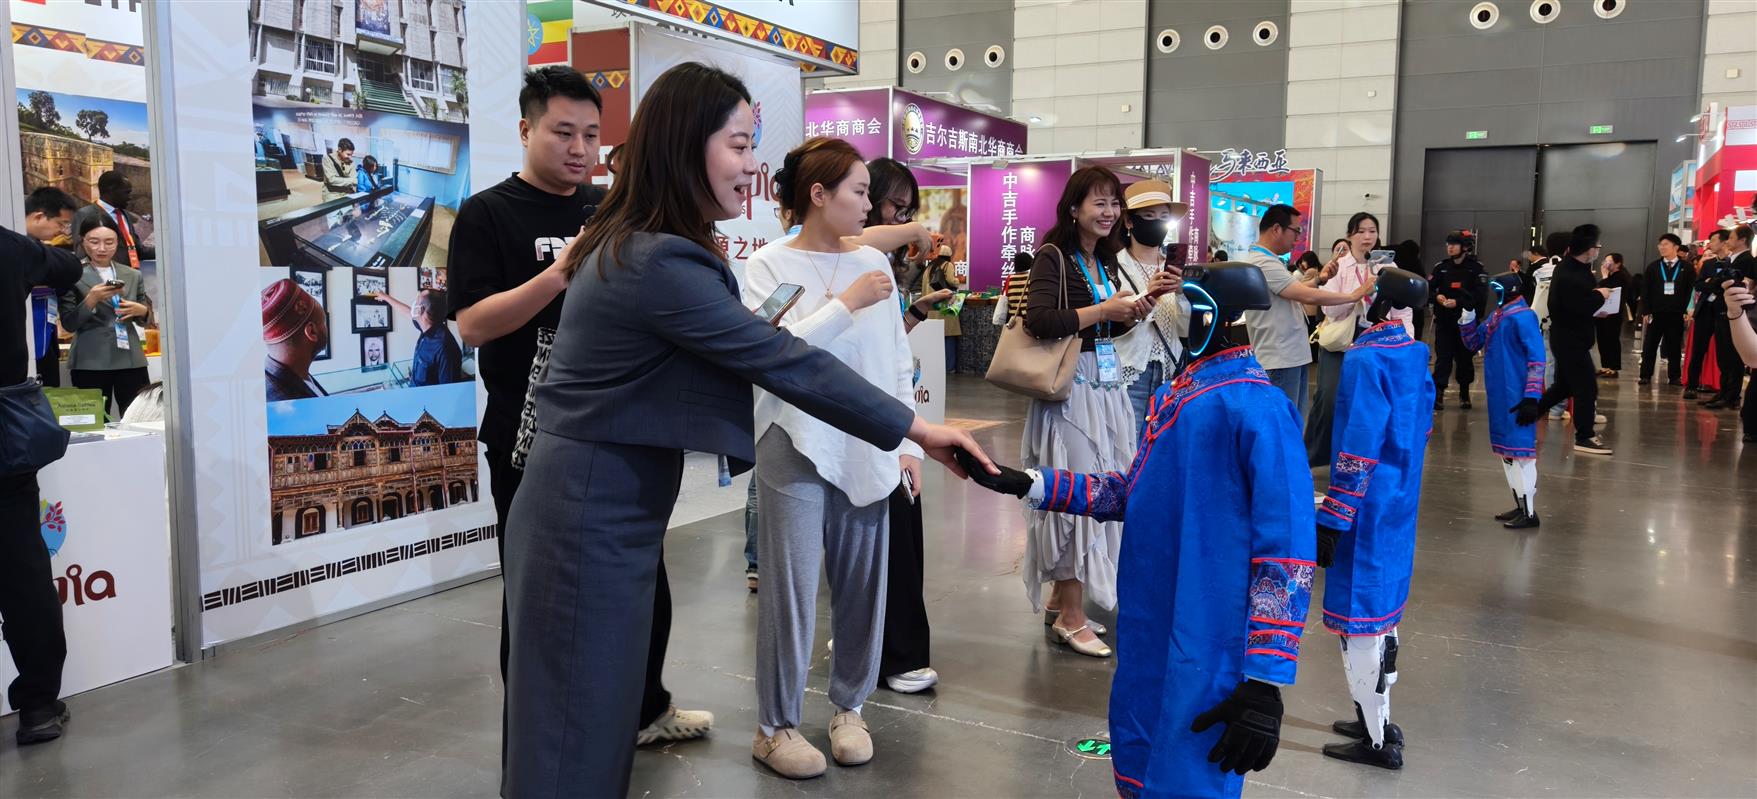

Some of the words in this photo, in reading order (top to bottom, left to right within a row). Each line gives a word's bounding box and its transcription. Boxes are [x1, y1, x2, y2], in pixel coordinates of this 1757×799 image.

[806, 117, 882, 138] 北华商商会
[1209, 148, 1291, 182] 马来西亚
